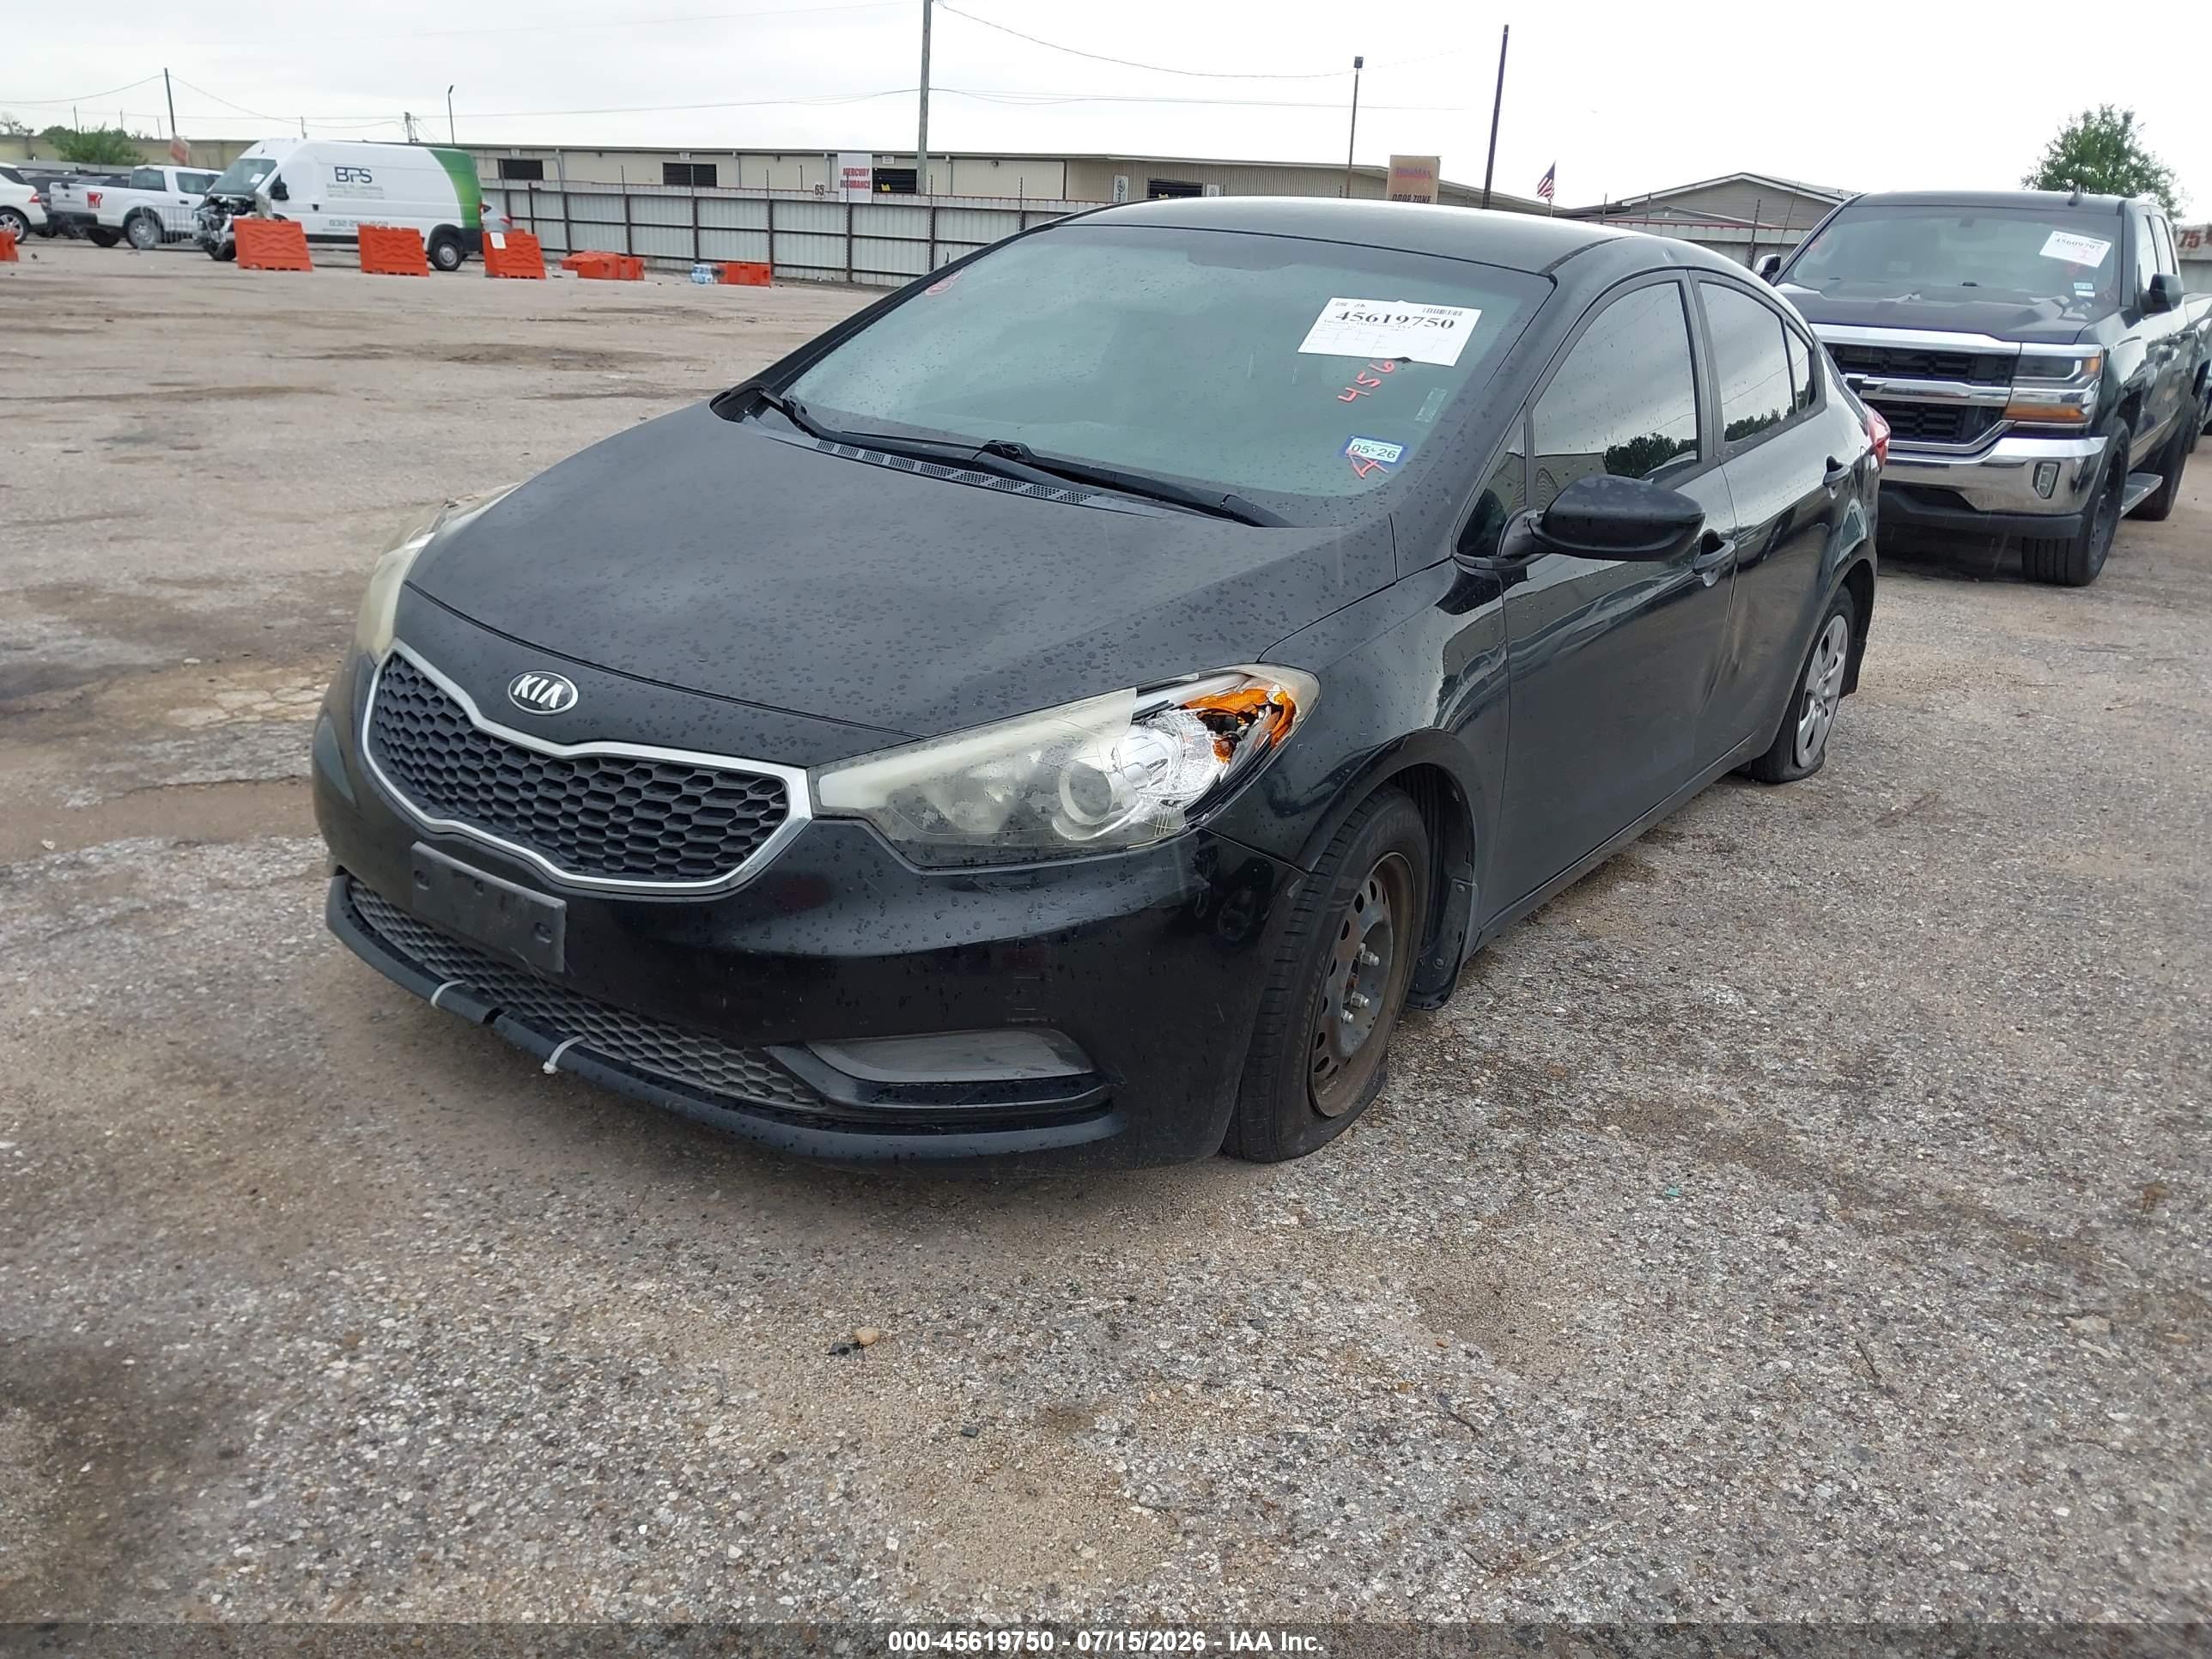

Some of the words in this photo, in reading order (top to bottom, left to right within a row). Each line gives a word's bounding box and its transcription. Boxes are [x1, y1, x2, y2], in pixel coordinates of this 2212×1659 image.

[334, 166, 373, 184] BPS
[842, 167, 870, 177] MERCURY
[814, 184, 824, 197] 65
[2179, 229, 2201, 248] 75
[1335, 310, 1455, 330] 45619750
[514, 674, 564, 709] KIA
